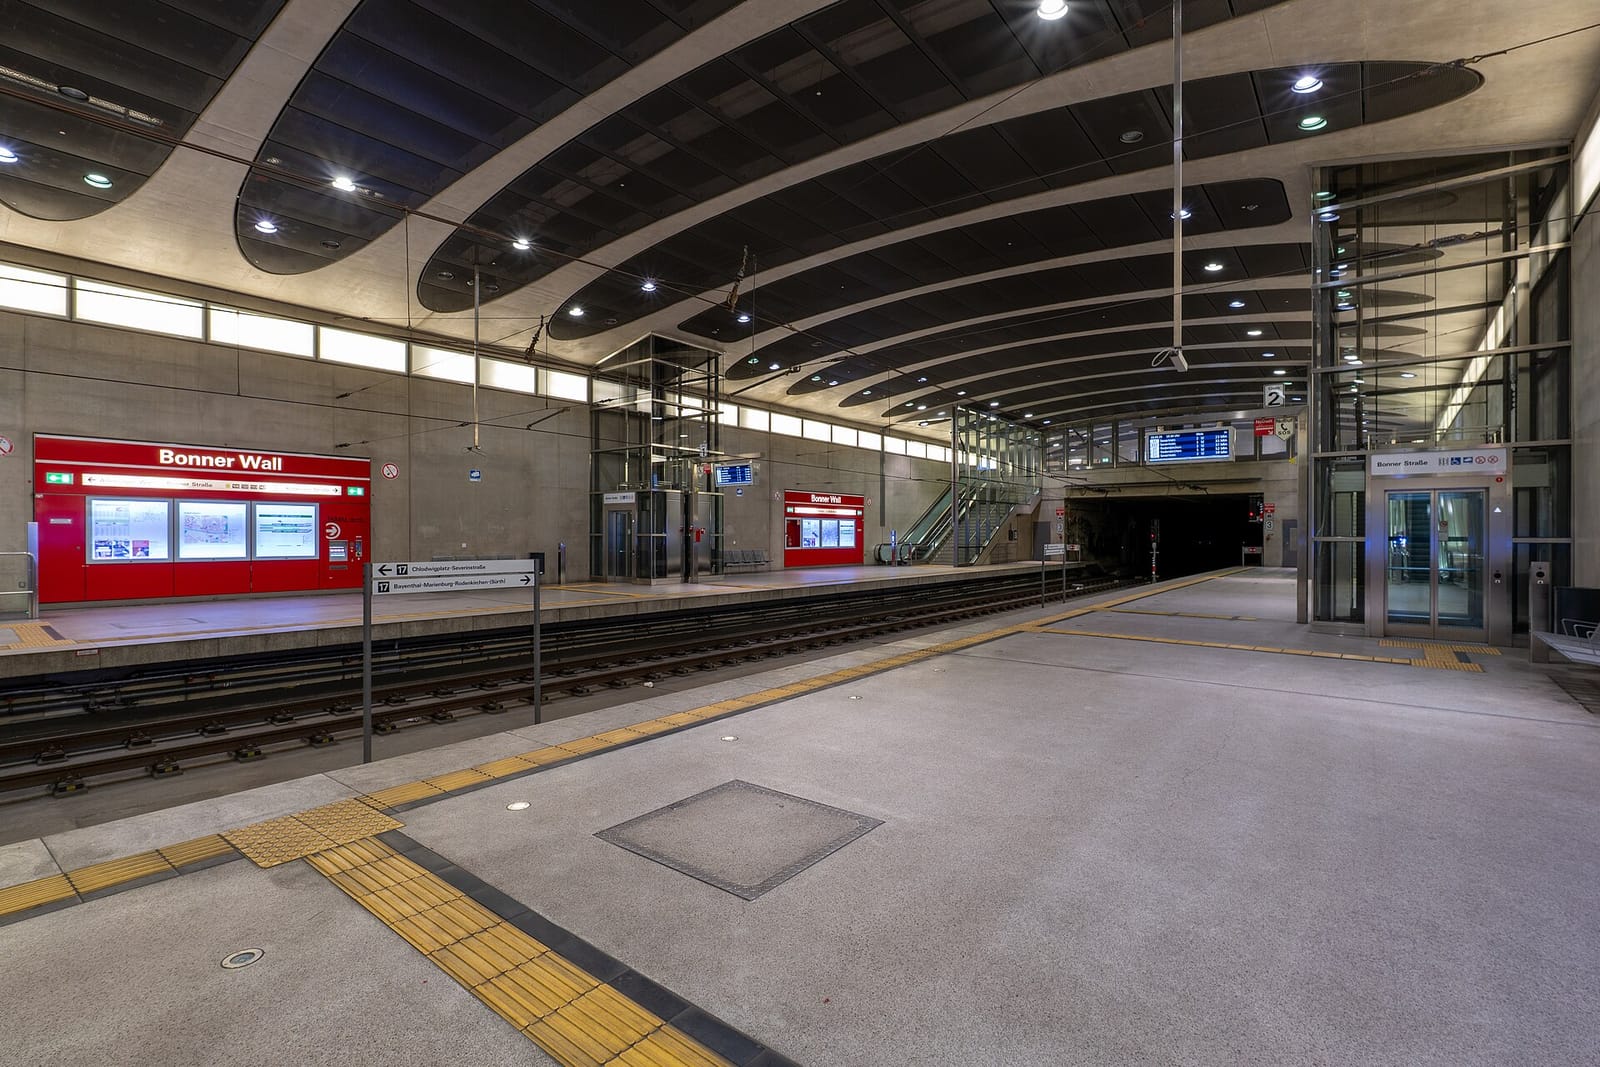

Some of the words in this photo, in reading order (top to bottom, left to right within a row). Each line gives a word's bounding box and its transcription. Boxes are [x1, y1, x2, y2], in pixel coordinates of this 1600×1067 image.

[1268, 391, 1280, 405] 2
[159, 449, 235, 467] Bonner
[239, 454, 282, 471] Wall
[811, 495, 829, 503] Bonner
[397, 565, 407, 574] 17
[379, 583, 388, 591] 17
